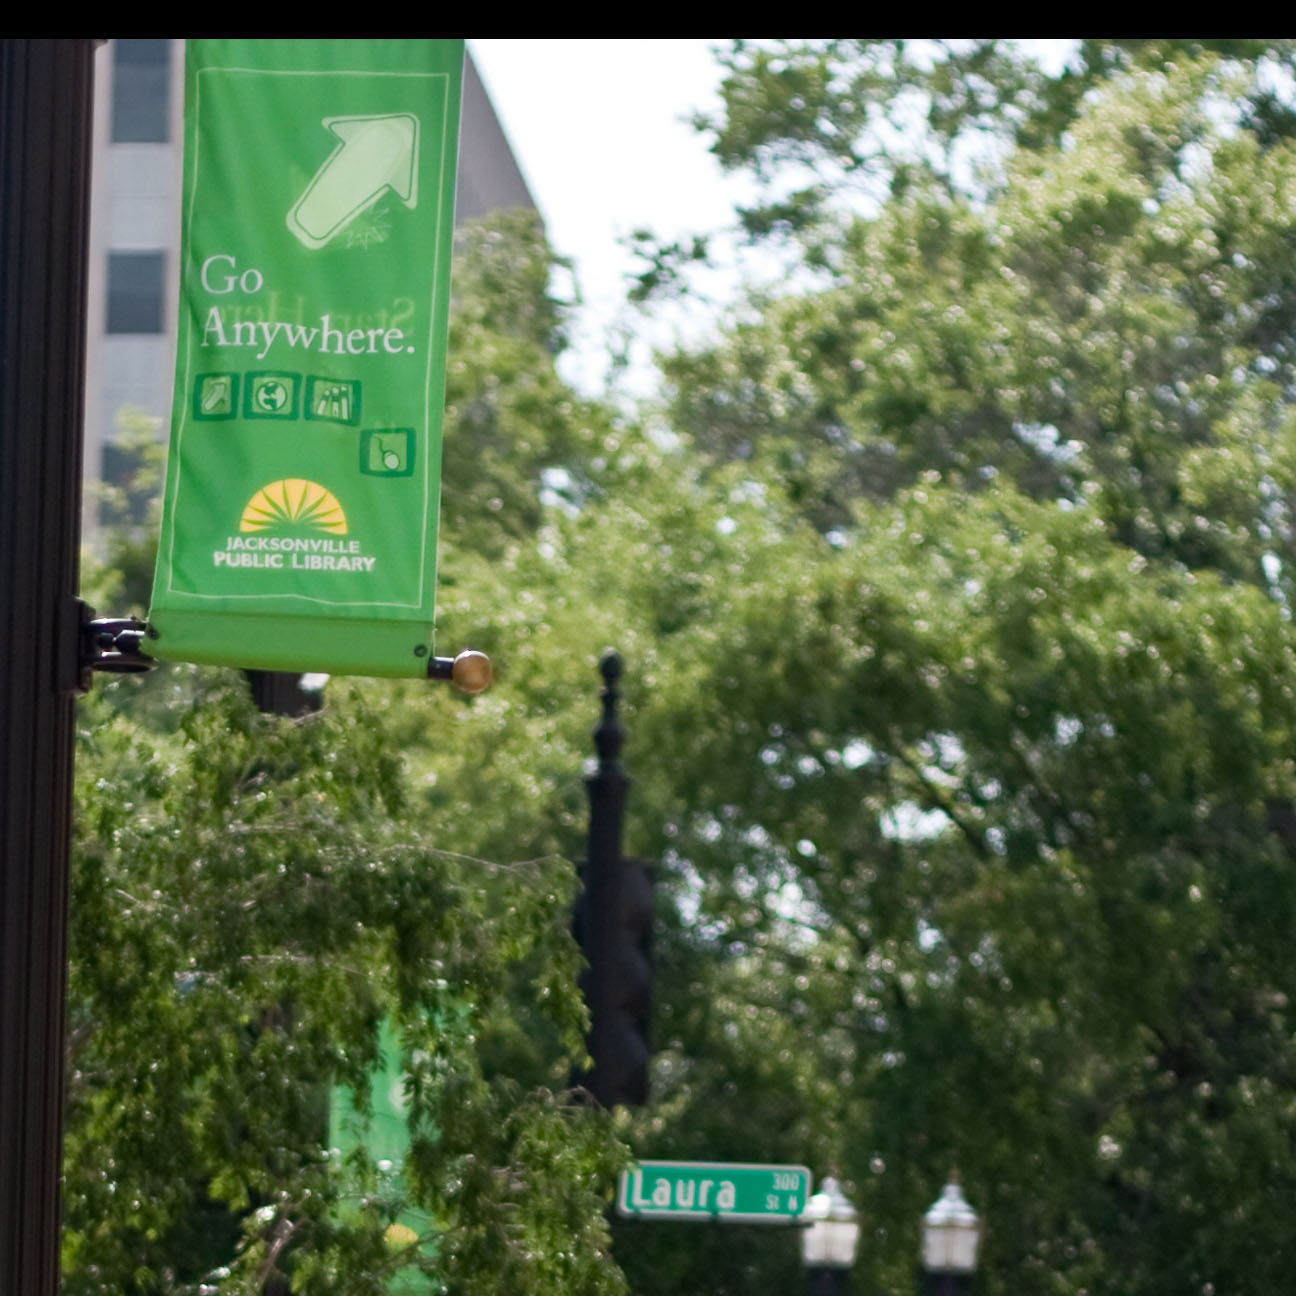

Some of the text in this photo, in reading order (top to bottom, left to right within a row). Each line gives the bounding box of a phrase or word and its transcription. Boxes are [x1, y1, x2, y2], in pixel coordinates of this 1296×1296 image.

[200, 254, 264, 295] Go
[200, 305, 416, 360] Anywhere.
[226, 536, 361, 554] JACKSONVILLE
[213, 551, 376, 572] PUBLIC LIBRARY
[632, 1167, 736, 1210] Laura
[771, 1172, 801, 1191] 300
[765, 1193, 780, 1211] St
